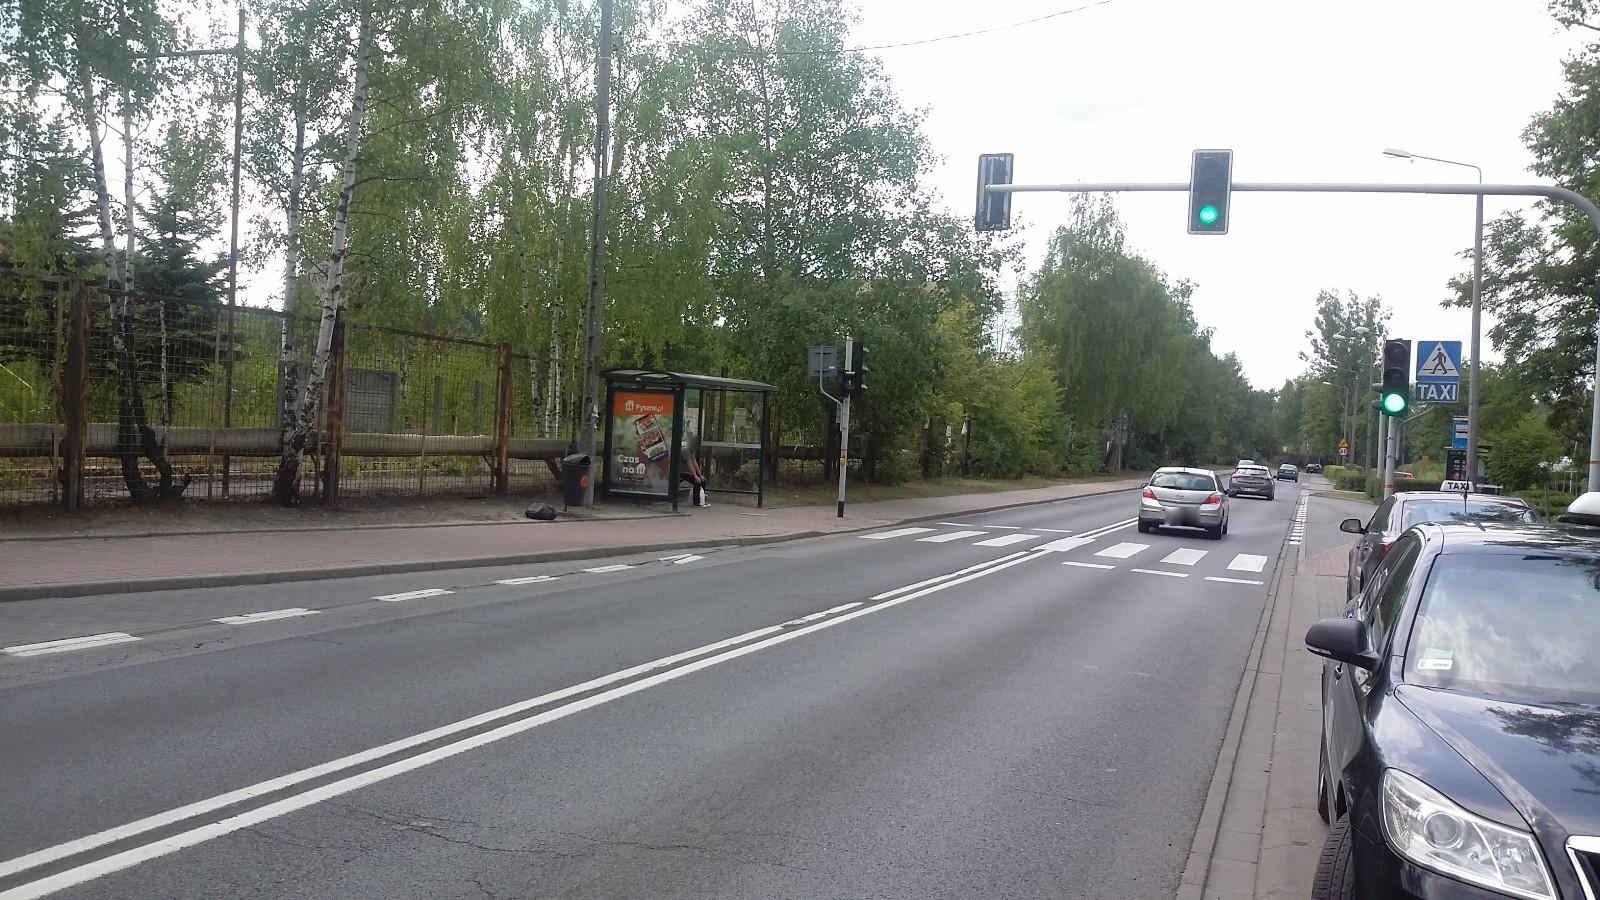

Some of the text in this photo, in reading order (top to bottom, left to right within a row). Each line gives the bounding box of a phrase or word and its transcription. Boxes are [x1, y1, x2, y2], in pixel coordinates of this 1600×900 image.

[1417, 384, 1456, 400] TAXI
[617, 454, 640, 464] Czas
[622, 466, 635, 474] na
[1447, 482, 1470, 491] TAXI
